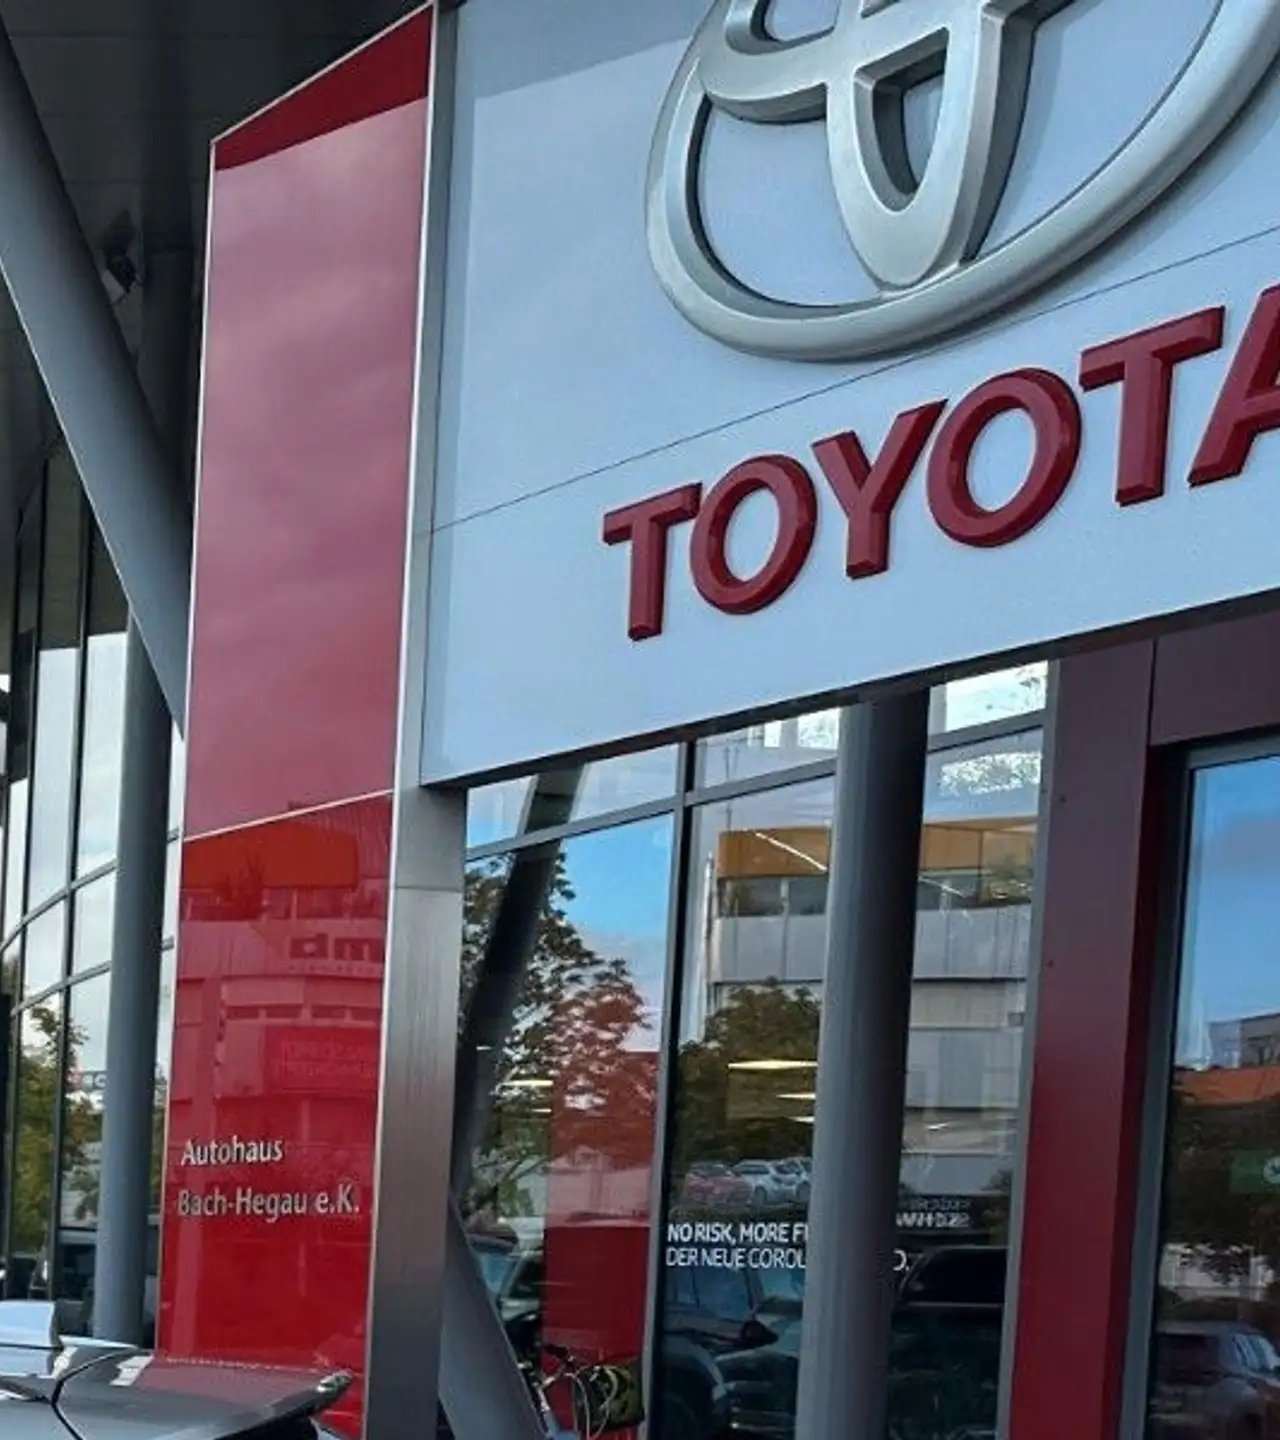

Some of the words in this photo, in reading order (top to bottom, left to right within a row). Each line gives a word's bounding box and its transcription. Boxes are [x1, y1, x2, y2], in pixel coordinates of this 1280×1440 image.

[180, 1134, 284, 1167] Autohaus
[177, 1186, 308, 1223] Bach-Hegau
[314, 1183, 360, 1215] e.K.
[667, 1222, 693, 1243] NO
[694, 1222, 736, 1246] RISK,
[739, 1222, 790, 1243] MORE
[665, 1247, 698, 1267] DER
[700, 1247, 747, 1268] NEUE
